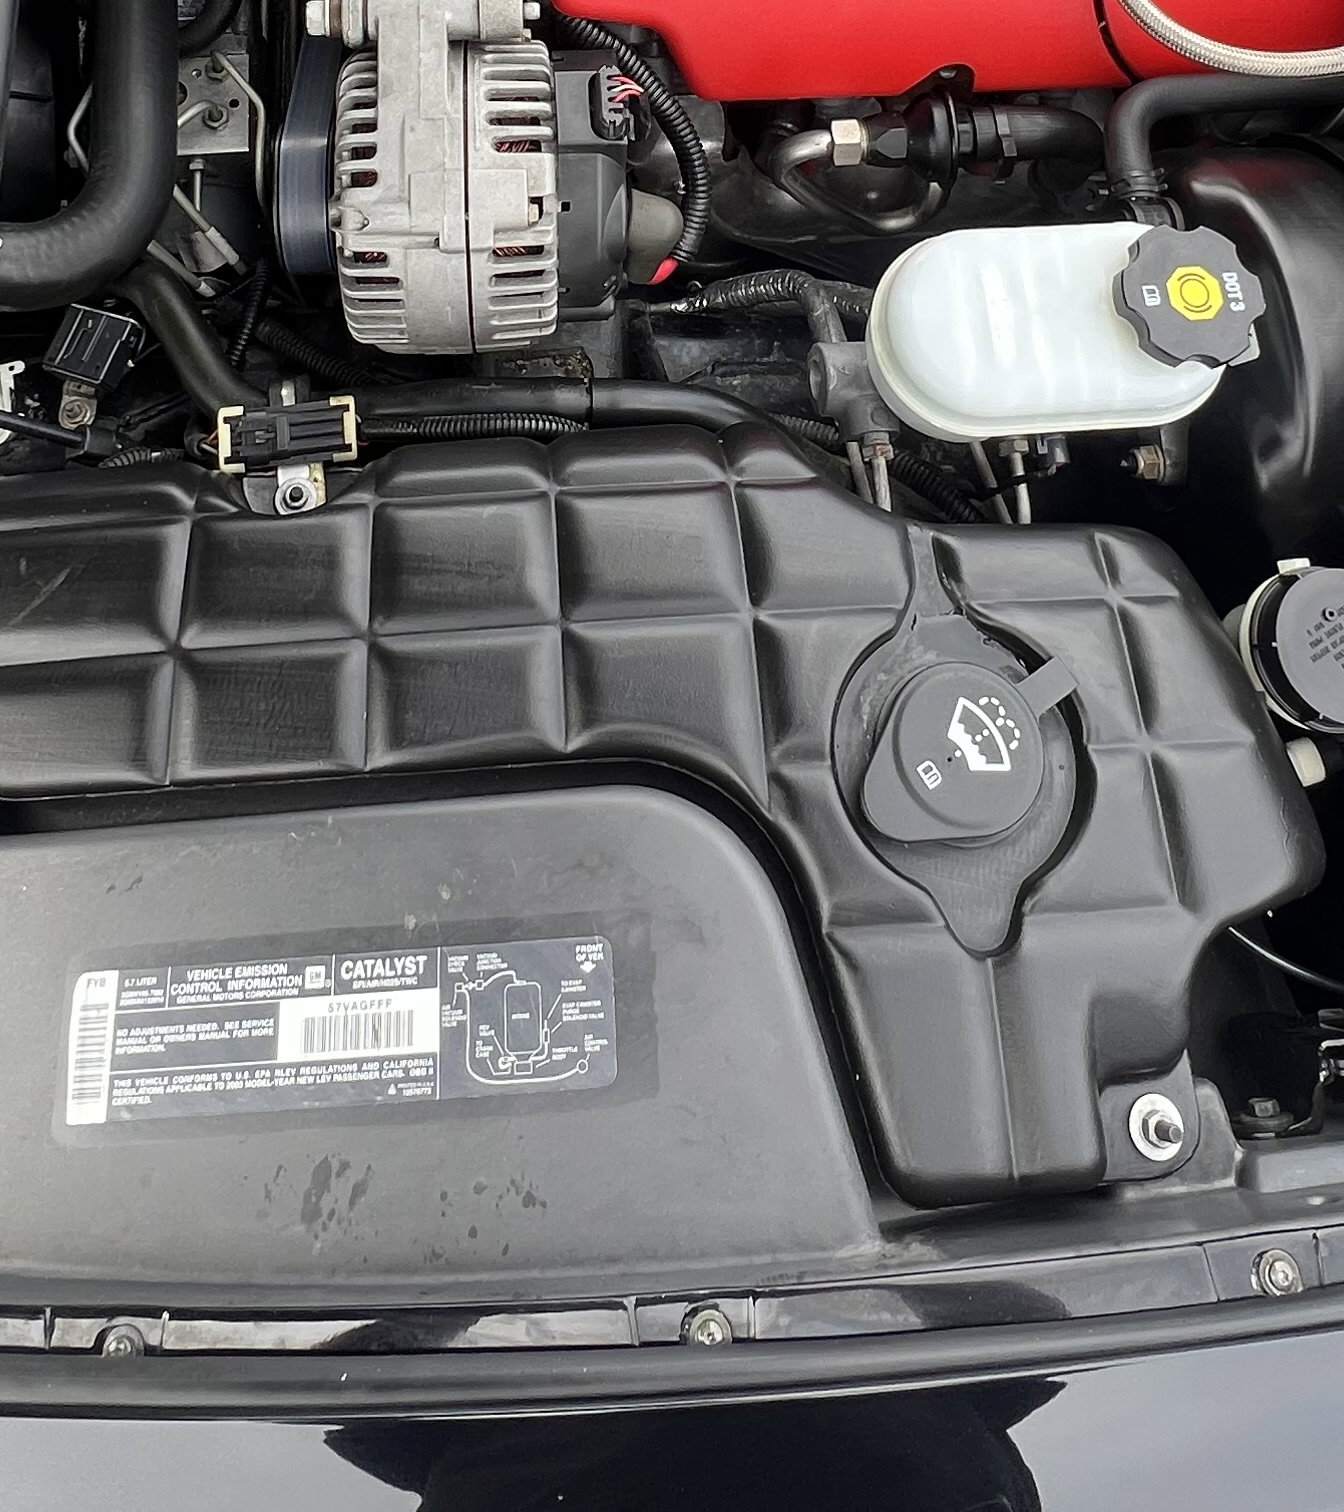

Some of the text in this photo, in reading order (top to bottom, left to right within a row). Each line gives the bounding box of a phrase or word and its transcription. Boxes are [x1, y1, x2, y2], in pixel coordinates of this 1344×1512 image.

[1221, 272, 1246, 312] DOT 3
[575, 943, 604, 953] FRONT
[186, 963, 288, 982] VEHICLE EMISSION
[310, 971, 322, 980] GM
[340, 955, 428, 980] CATALYST
[171, 981, 223, 996] CONTROL
[227, 974, 303, 991] INFORMATION
[176, 994, 212, 1005] GENERAL
[213, 991, 244, 1001] MOTORS
[245, 988, 299, 1000] CORPORATION
[116, 1028, 129, 1037] NO
[130, 1024, 185, 1036] ADJUSTMENTS
[224, 1020, 239, 1030] SEE
[241, 1018, 275, 1029] SERVICE
[116, 1036, 147, 1046] MANUAL
[198, 1031, 231, 1041] MANUAL
[232, 1029, 250, 1038] FOR
[113, 1078, 132, 1088] THIS
[135, 1076, 169, 1087] VEHICLE
[172, 1073, 218, 1084] CONFORMS
[221, 1071, 233, 1080] TO
[254, 1069, 271, 1078] EPA
[300, 1063, 358, 1076] REGULATIONS
[361, 1061, 380, 1071] AND
[383, 1058, 434, 1070] CALIFORNIA
[165, 1082, 213, 1094] APPLICABLE
[214, 1081, 225, 1090] TO
[297, 1075, 315, 1085] NEW
[333, 1070, 381, 1082] PASSENGER
